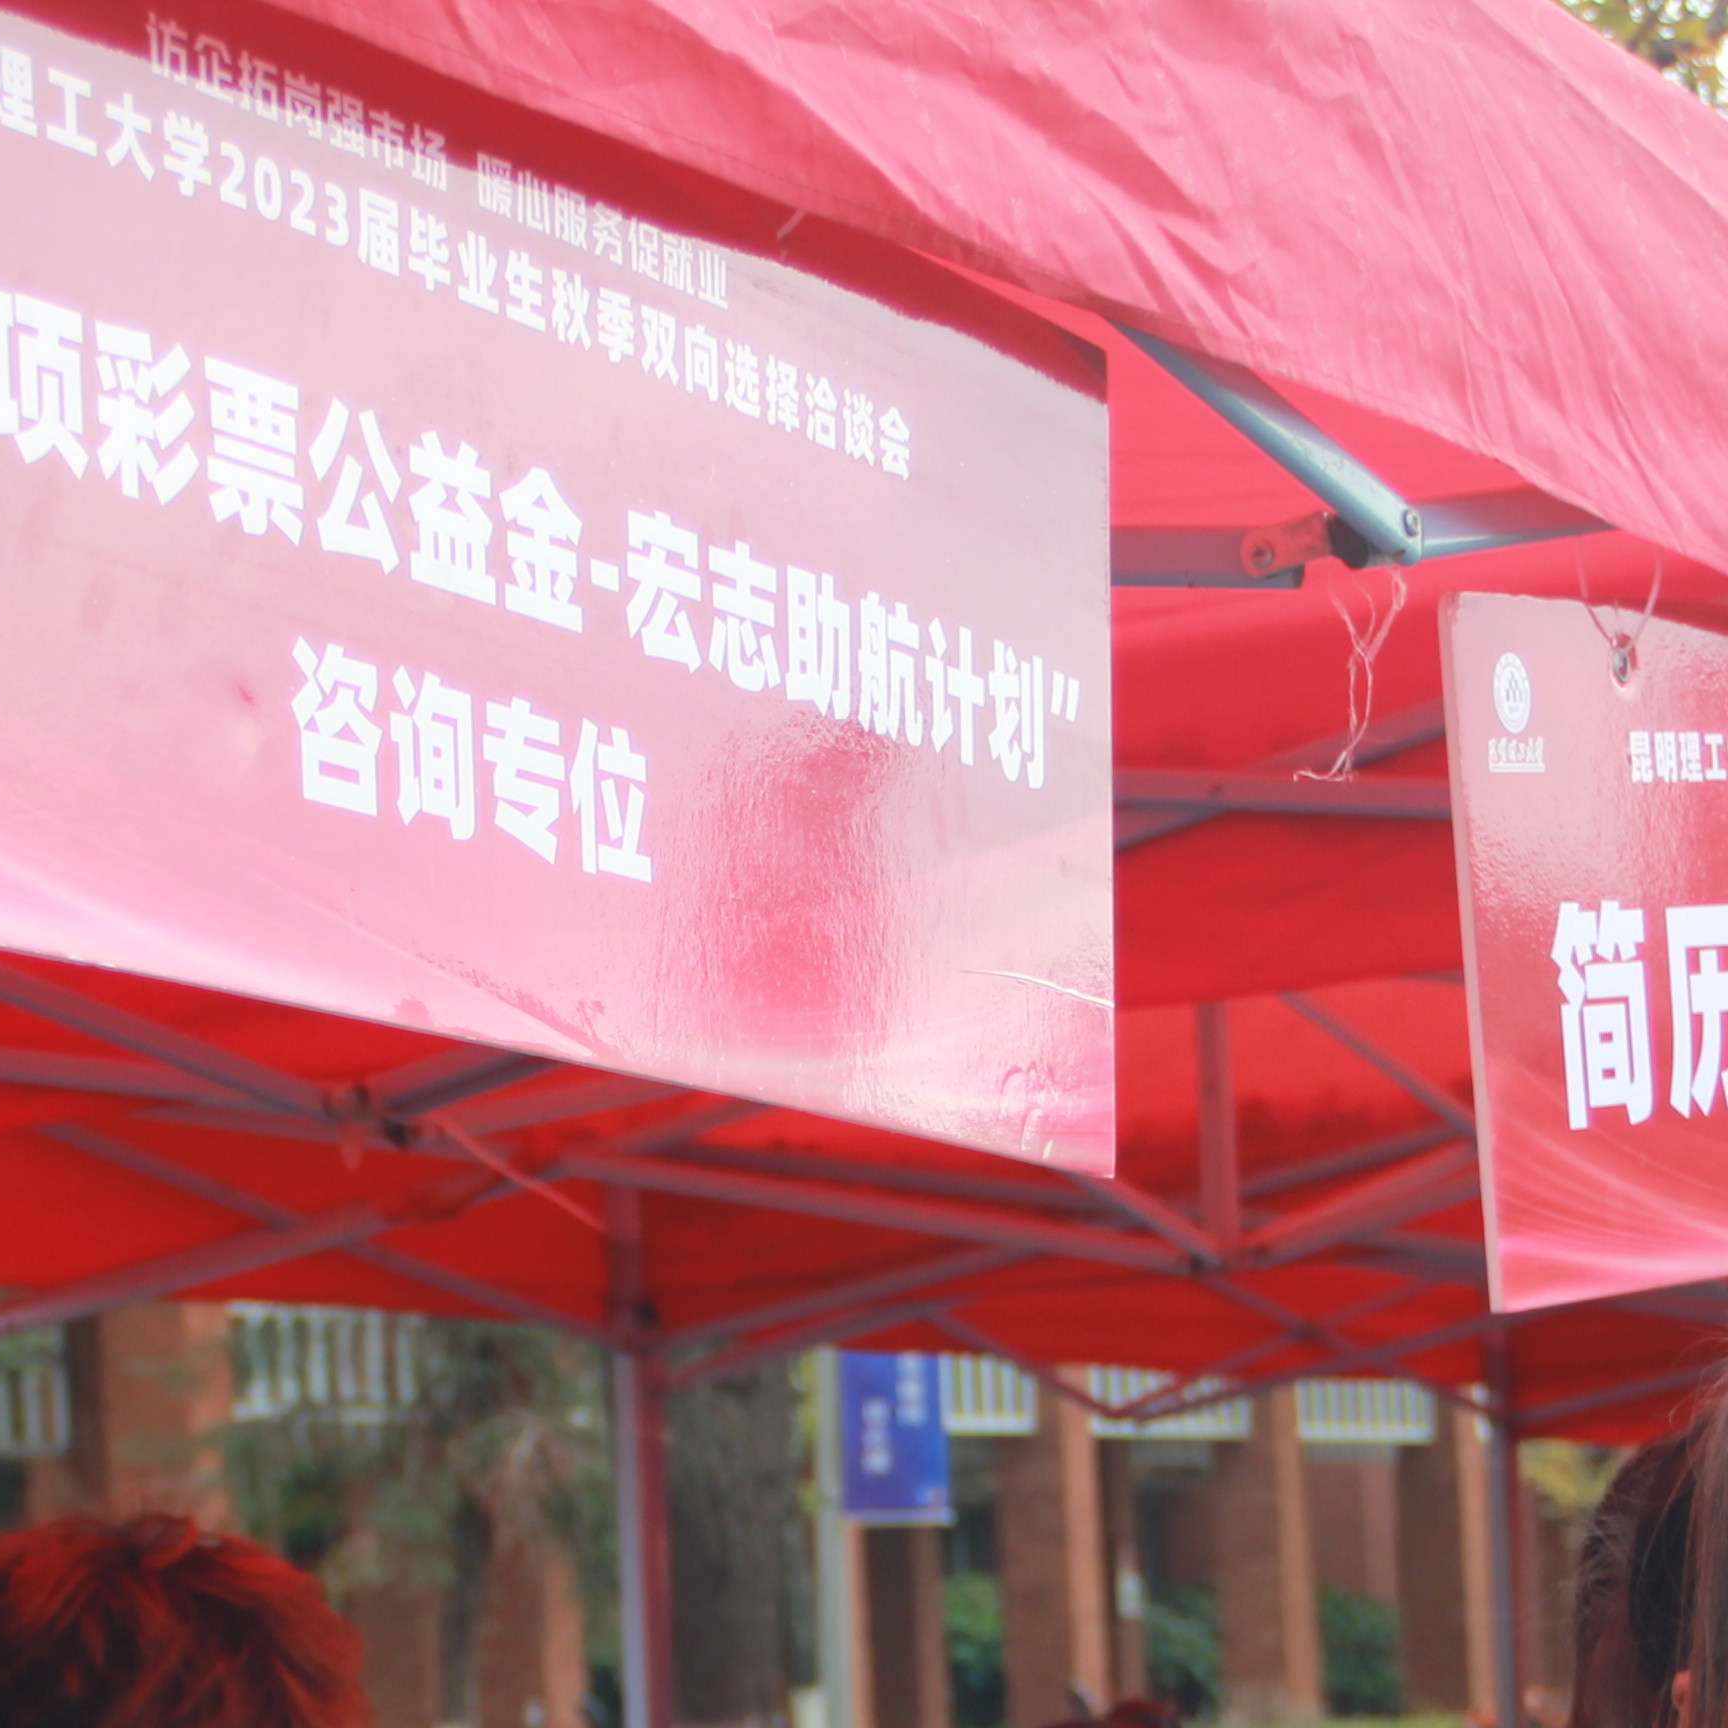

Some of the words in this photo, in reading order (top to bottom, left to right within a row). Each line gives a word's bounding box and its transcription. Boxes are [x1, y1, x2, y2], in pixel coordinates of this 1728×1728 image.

[145, 11, 448, 192] 访企拓岗强市场
[477, 152, 729, 310] 暖心服务促就业
[293, 635, 653, 884] 咨询专位
